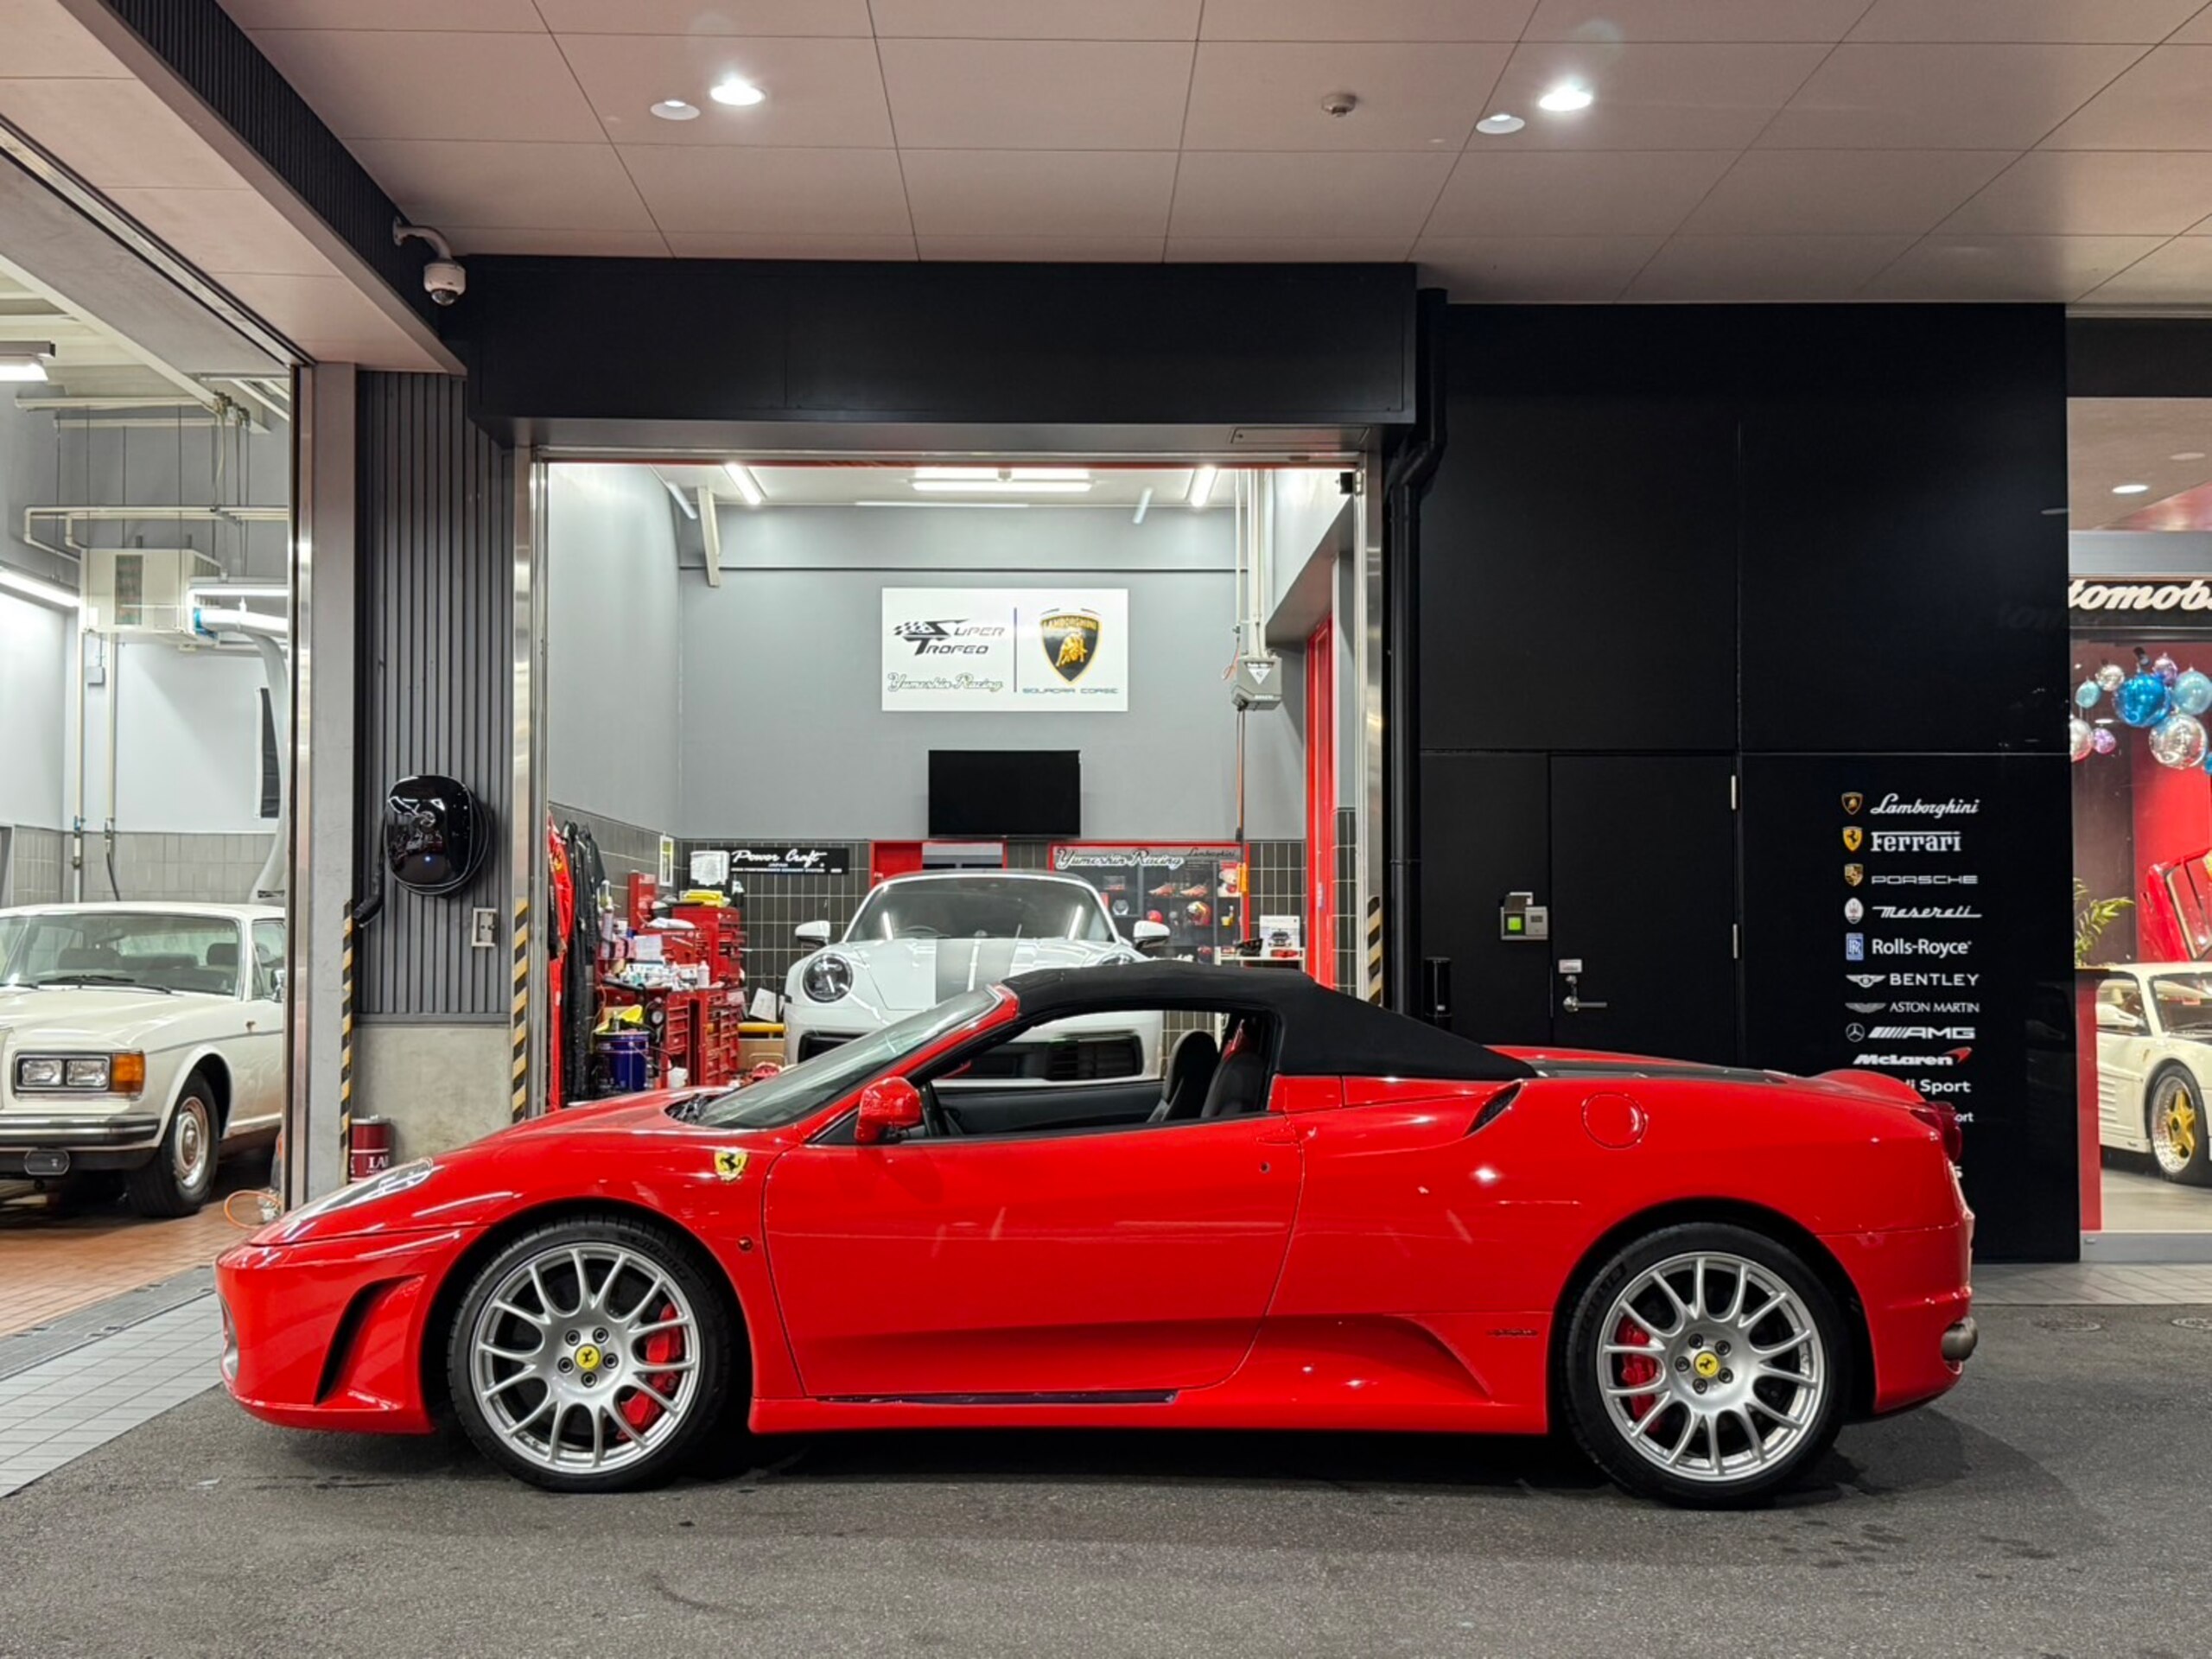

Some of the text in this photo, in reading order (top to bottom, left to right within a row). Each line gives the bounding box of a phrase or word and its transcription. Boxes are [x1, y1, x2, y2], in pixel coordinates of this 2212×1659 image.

[2069, 580, 2212, 610] tomob
[902, 636, 989, 656] TROFEO
[1870, 792, 1980, 818] Lamborghini
[1870, 831, 1961, 851] Ferrari
[731, 849, 828, 868] Power Craft
[1872, 875, 1978, 884] PORSCHE
[1872, 906, 1982, 918] Maserati
[1890, 973, 1980, 986] BENTLEY
[1890, 1001, 1980, 1013] ASTON MARTIN
[1853, 1053, 1954, 1065] McLaren
[1920, 1078, 1971, 1095] Sport
[1955, 1111, 1974, 1122] ort
